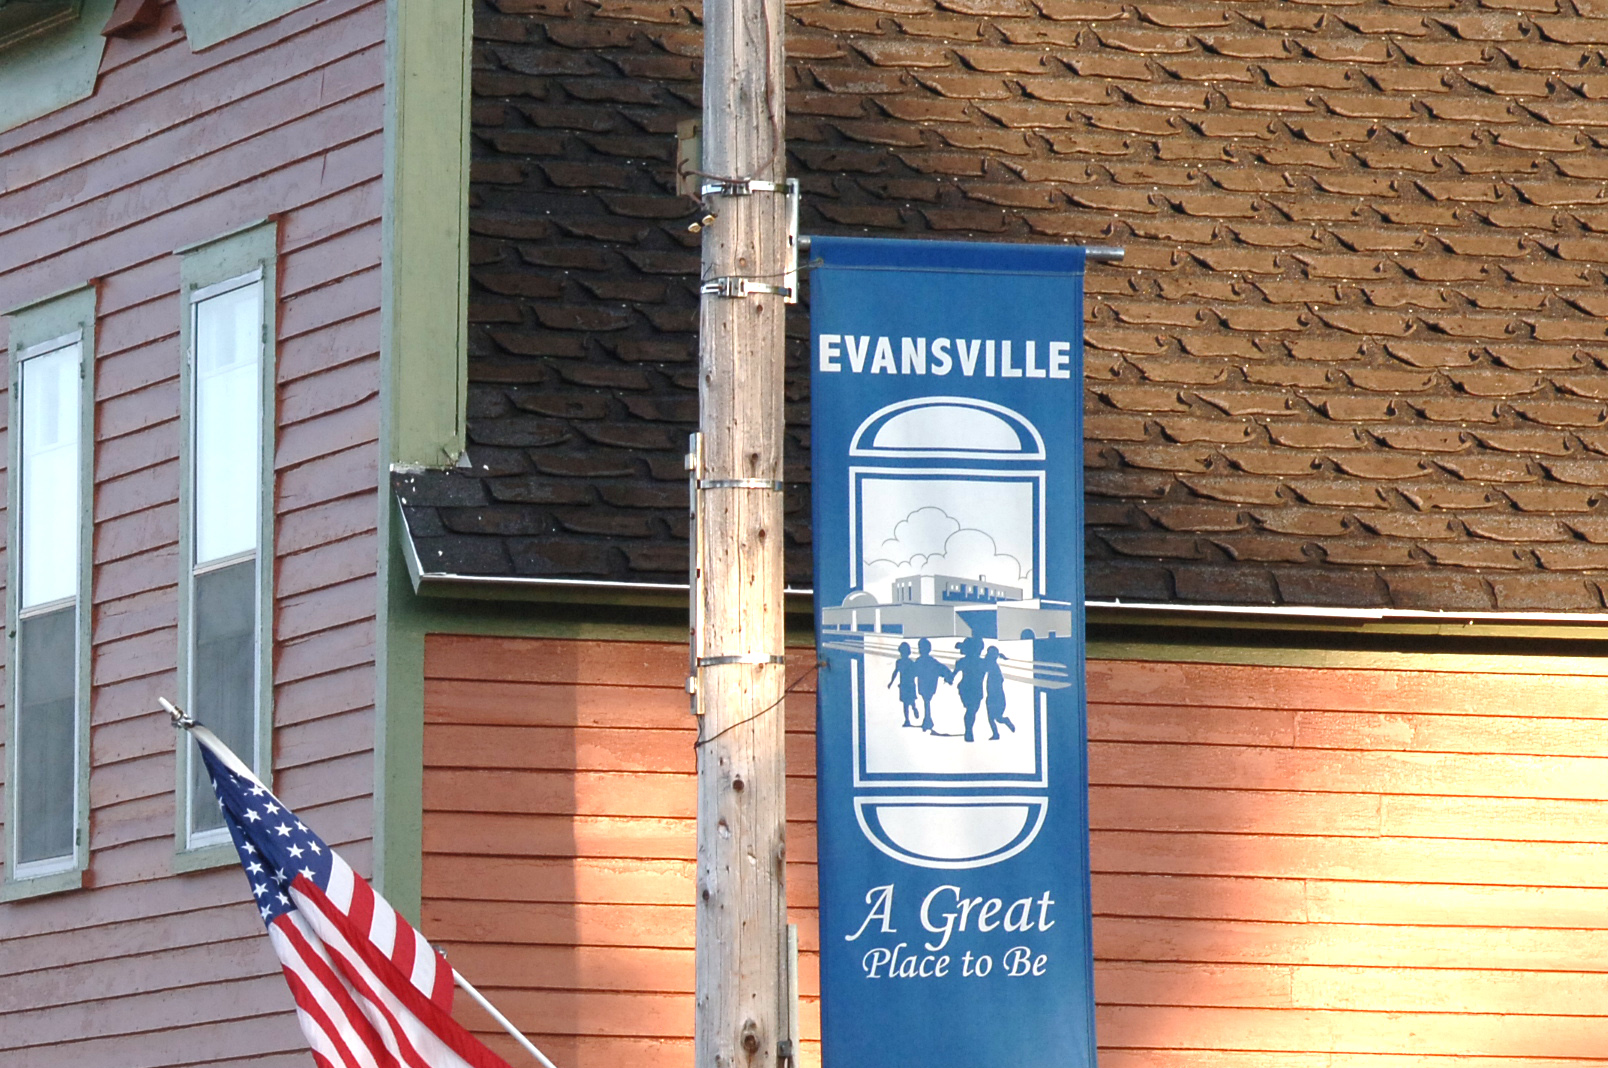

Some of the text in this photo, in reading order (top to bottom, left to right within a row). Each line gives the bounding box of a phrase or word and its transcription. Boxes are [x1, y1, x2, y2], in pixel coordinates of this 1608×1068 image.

[819, 334, 1071, 379] EVANSVILLE
[844, 883, 1056, 952] A Great
[862, 942, 1048, 979] Place to Be
